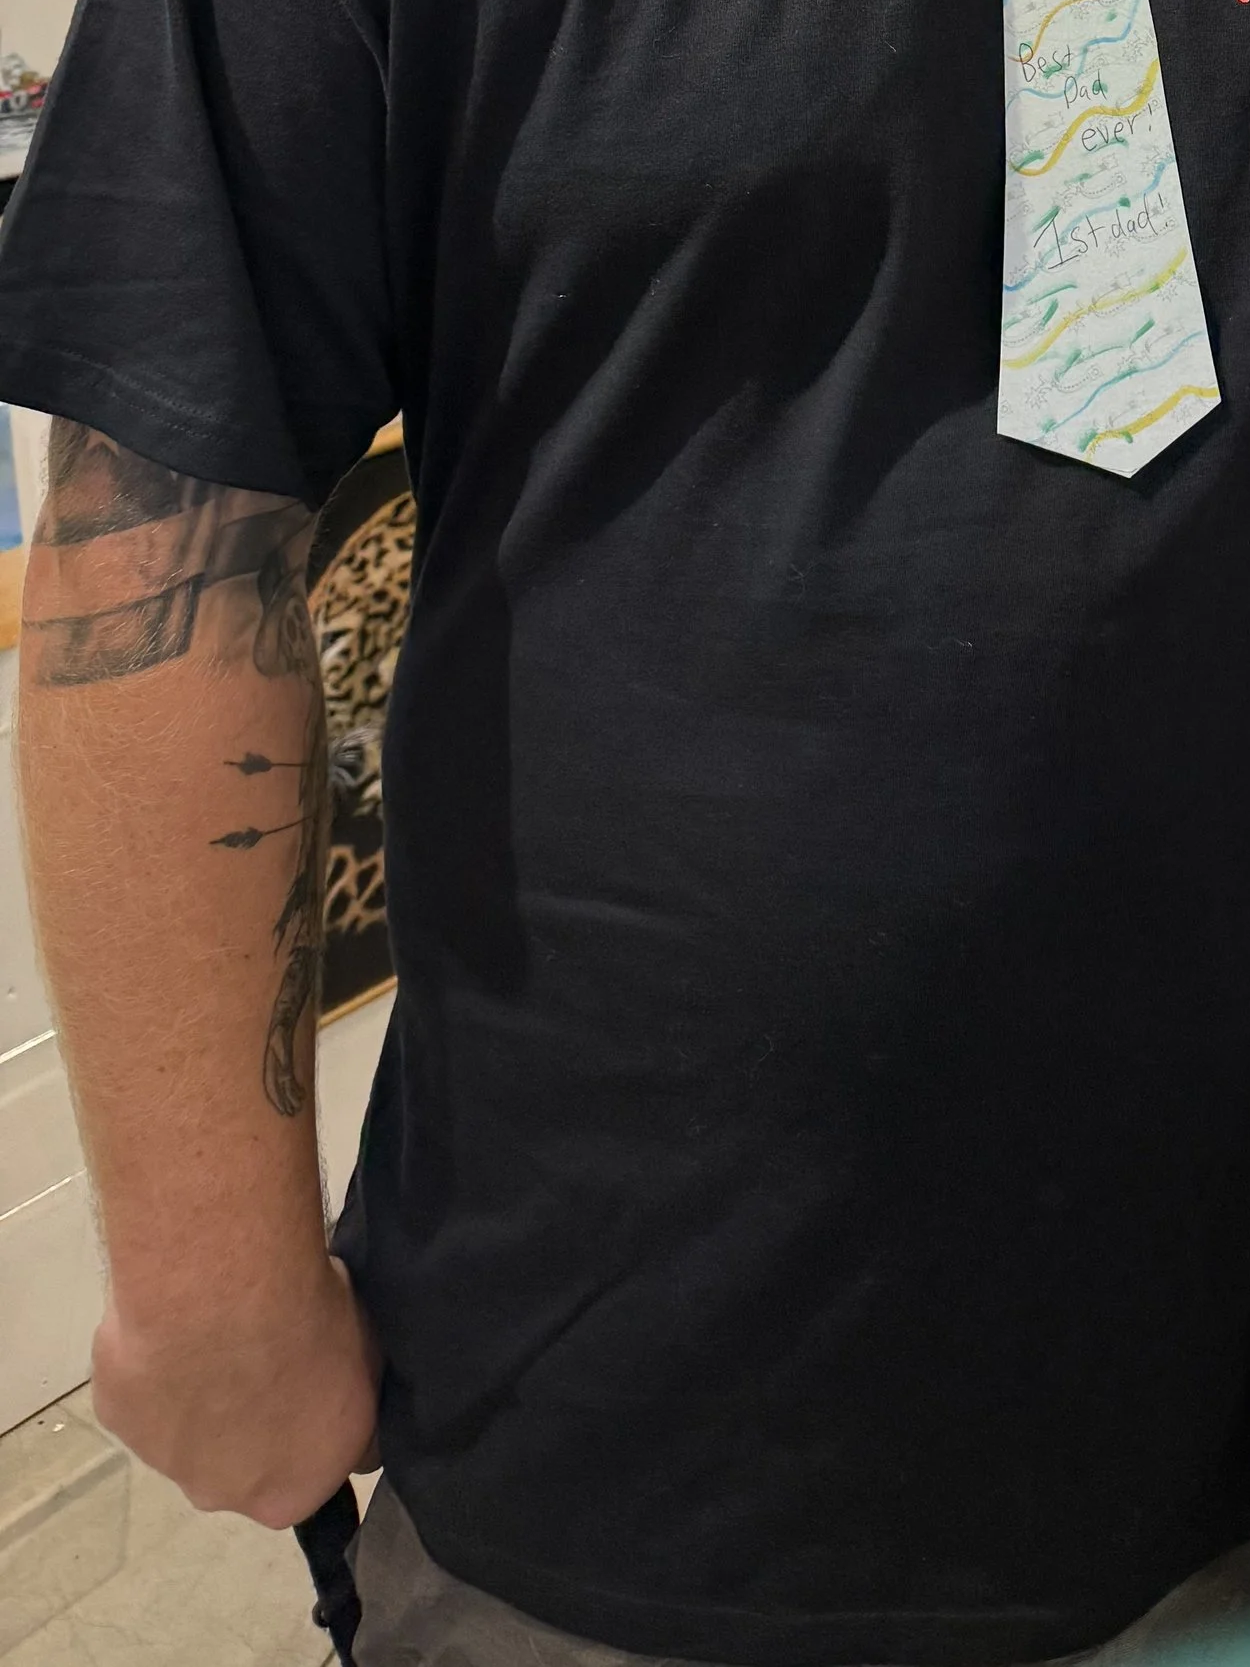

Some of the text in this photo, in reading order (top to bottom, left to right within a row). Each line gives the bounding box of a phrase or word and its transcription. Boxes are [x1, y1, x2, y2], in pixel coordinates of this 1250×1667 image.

[1019, 43, 1073, 82] Best
[1063, 70, 1107, 109] Dad
[1081, 103, 1153, 152] ever!
[1110, 192, 1171, 239] dad!
